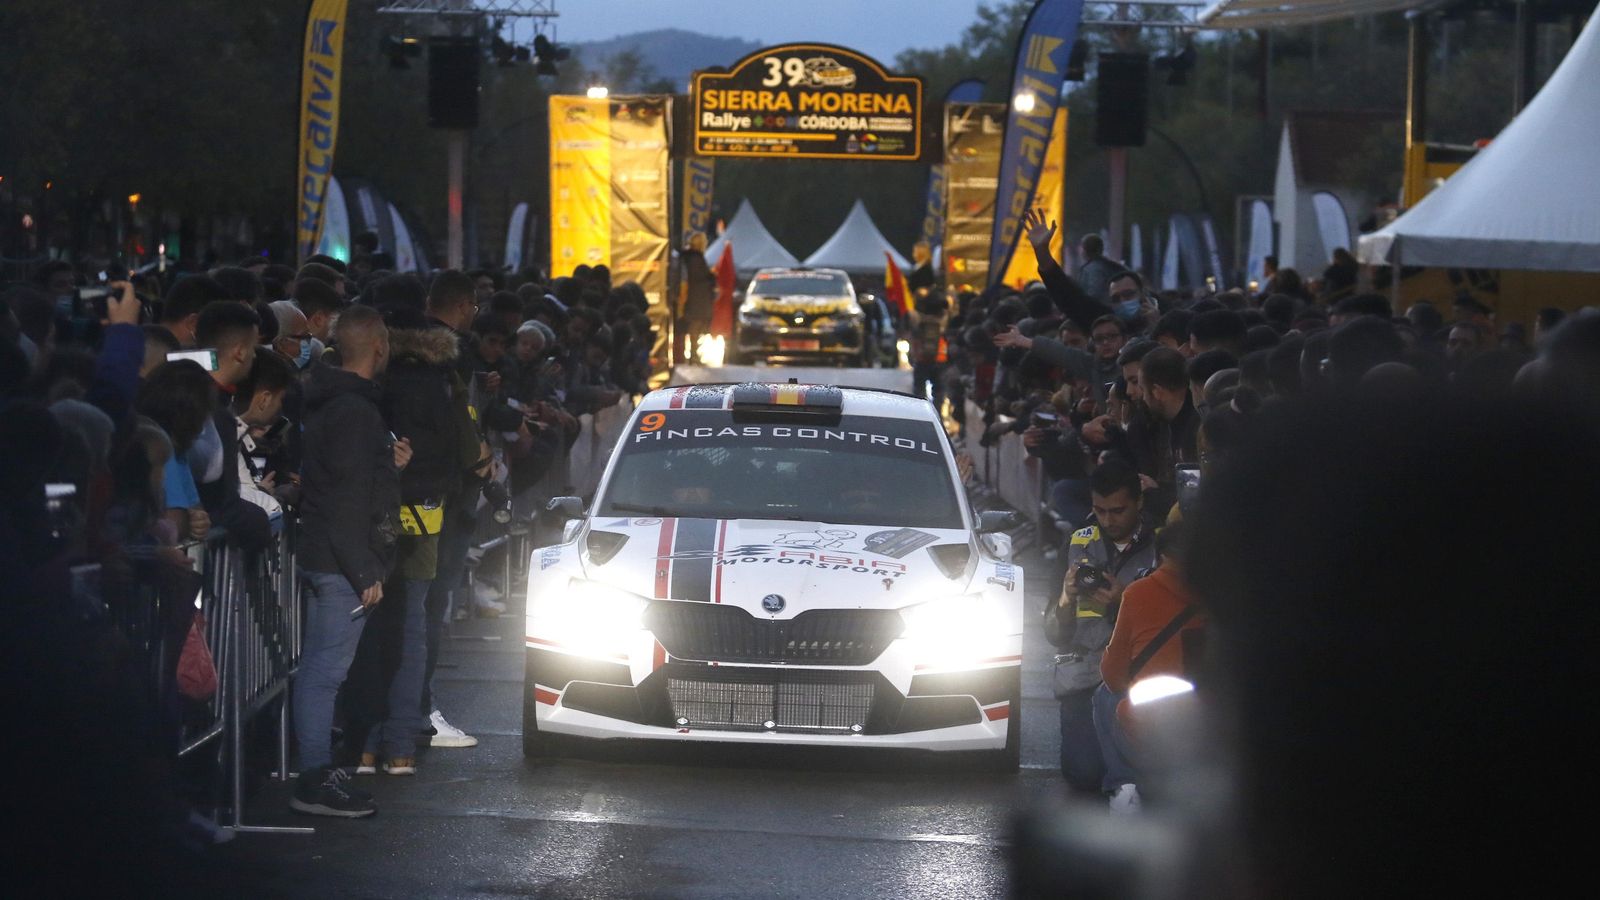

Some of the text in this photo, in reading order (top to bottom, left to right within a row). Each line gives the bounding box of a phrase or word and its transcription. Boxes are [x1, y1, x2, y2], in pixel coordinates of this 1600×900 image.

[762, 57, 805, 88] 39
[703, 89, 913, 114] SIERRA MORENA
[702, 111, 752, 131] Rallye
[800, 114, 868, 131] CÓRDOBA
[639, 412, 667, 432] 9
[635, 427, 939, 455] FINCAS CONTROL
[716, 556, 906, 578] MOTORSPORT
